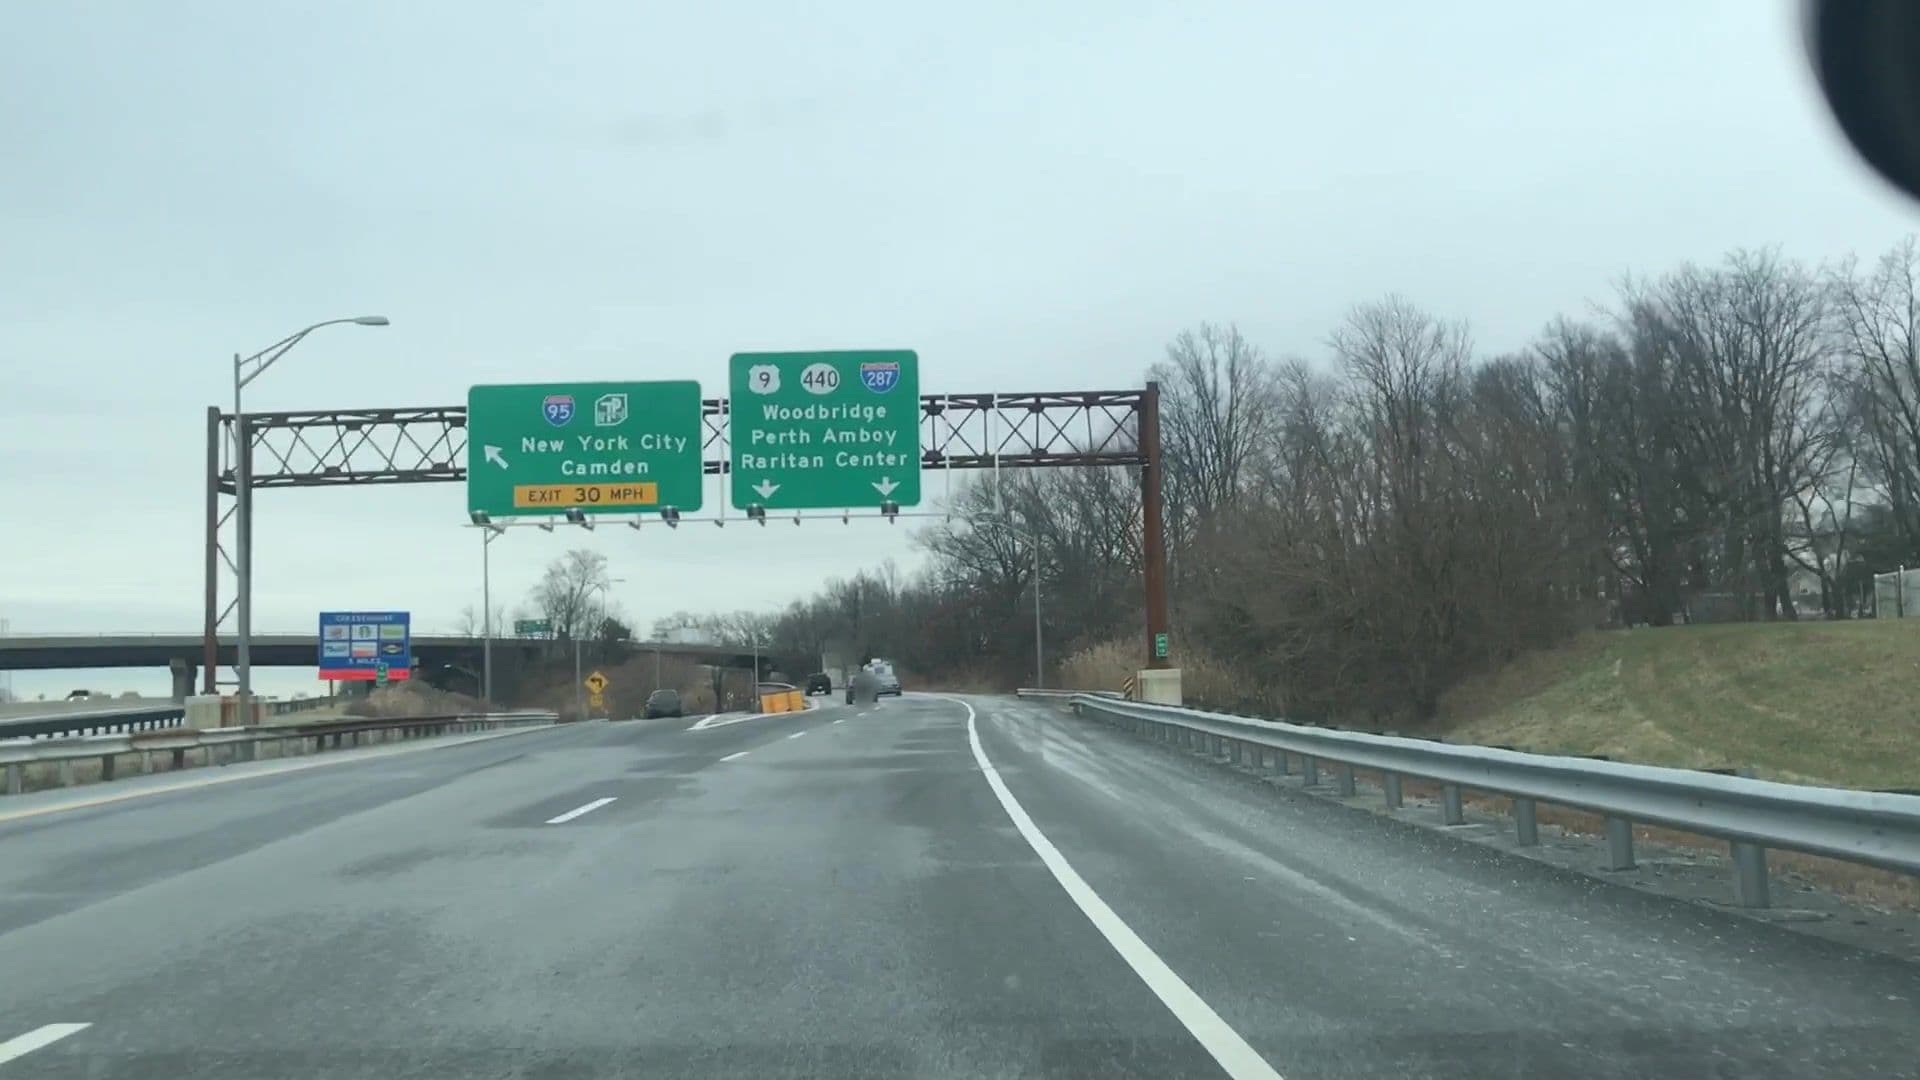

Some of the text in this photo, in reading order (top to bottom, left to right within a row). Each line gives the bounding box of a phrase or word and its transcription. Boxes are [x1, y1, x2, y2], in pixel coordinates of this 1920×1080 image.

[759, 371, 891, 387] 9 440 287
[547, 404, 569, 419] 95
[763, 404, 886, 421] Woodbridge
[522, 433, 686, 452] New York City
[751, 428, 896, 445] Perth Amboy
[561, 459, 648, 475] Camden
[741, 451, 907, 468] Raritan Center
[528, 487, 643, 502] EXIT 30 MPH
